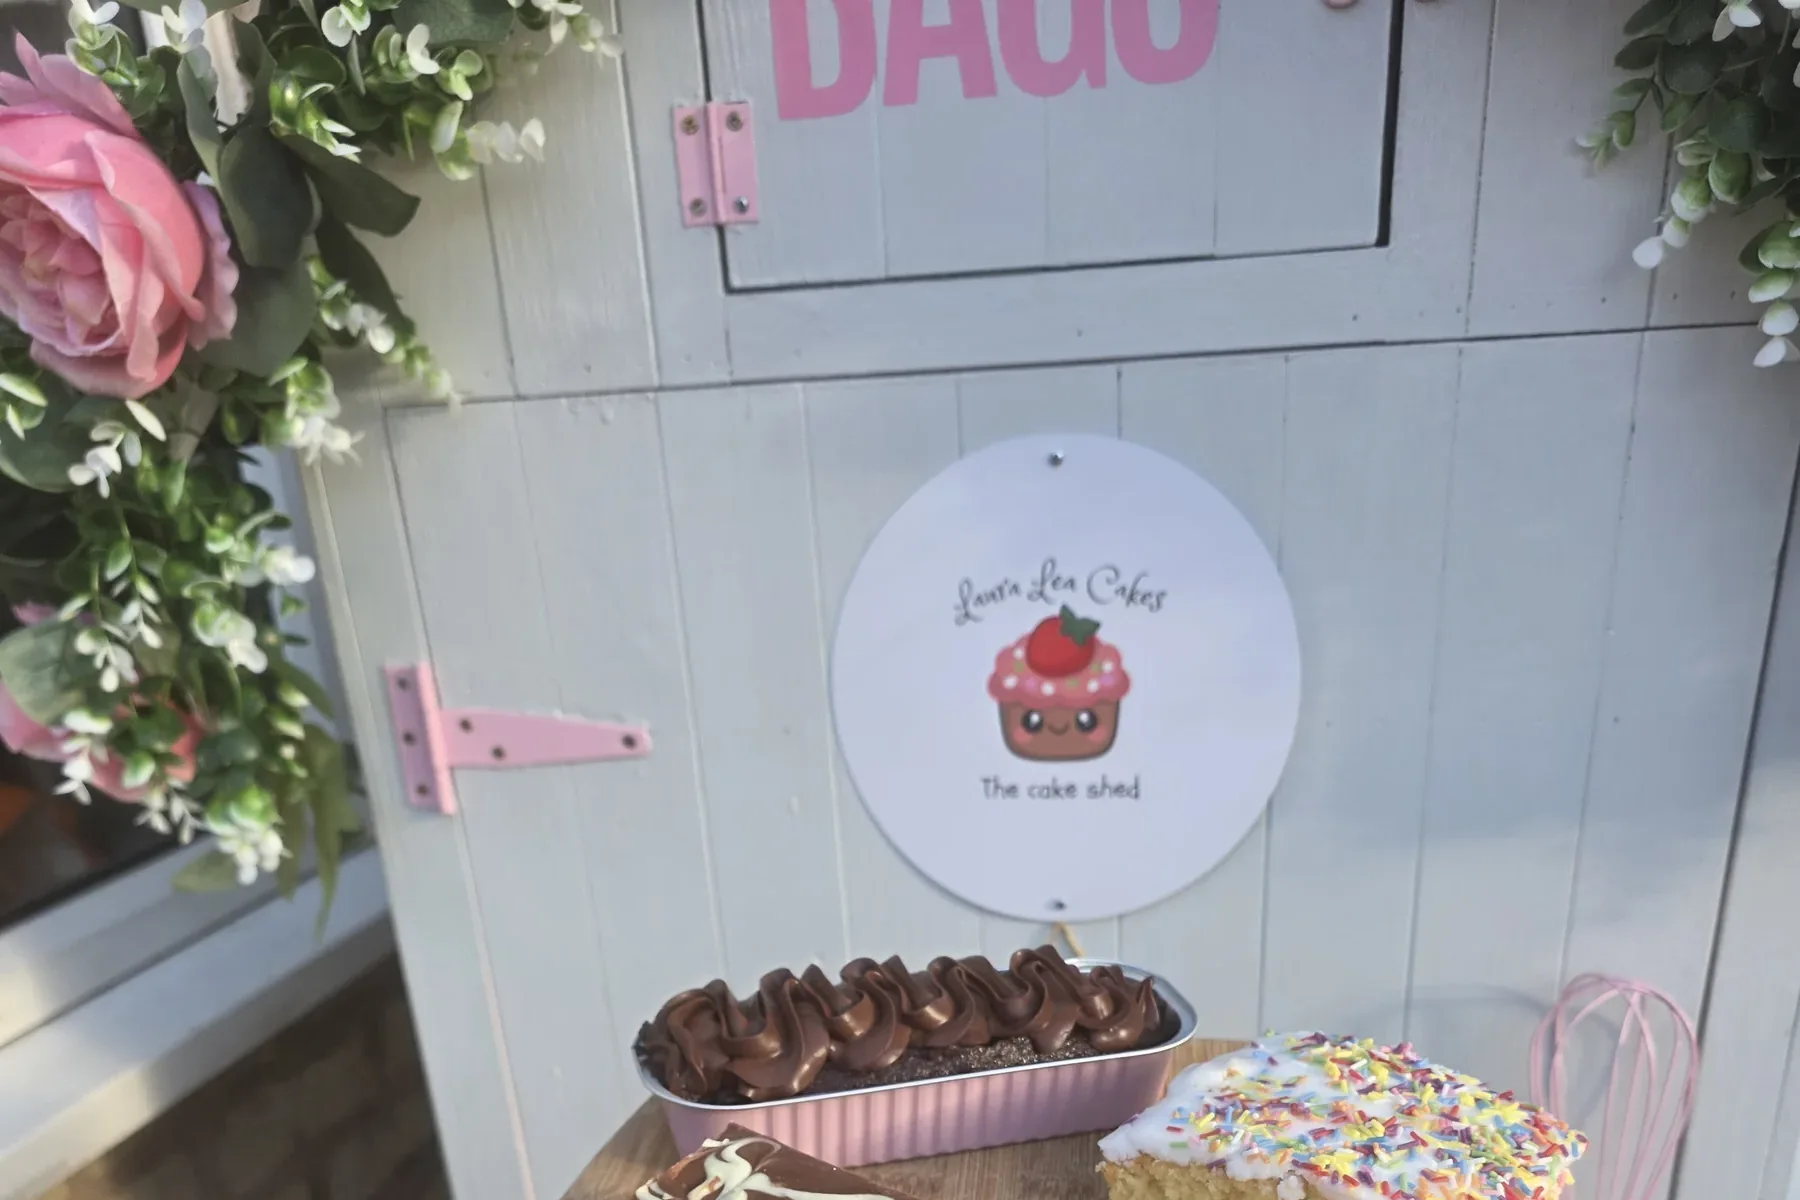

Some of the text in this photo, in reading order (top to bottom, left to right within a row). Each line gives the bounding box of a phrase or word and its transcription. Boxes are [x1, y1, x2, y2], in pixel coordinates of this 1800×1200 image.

[1086, 564, 1167, 613] Cakes
[981, 773, 1140, 801] The cake shed
